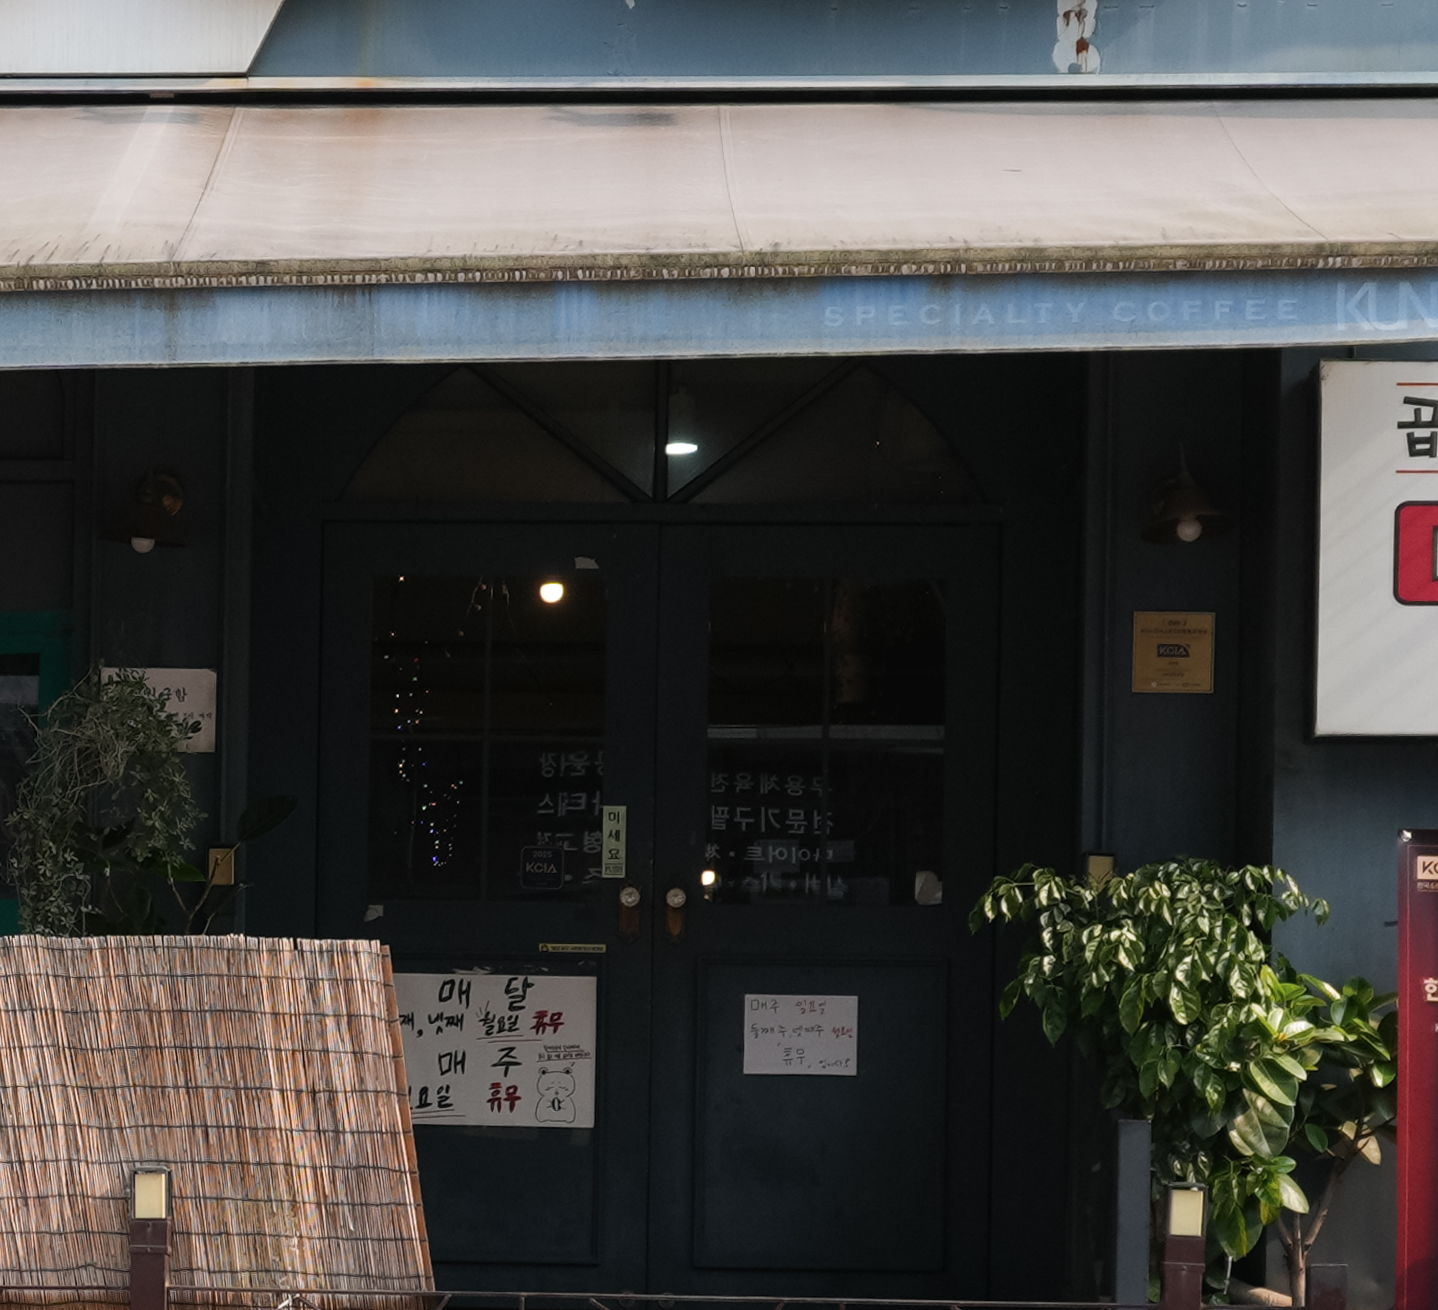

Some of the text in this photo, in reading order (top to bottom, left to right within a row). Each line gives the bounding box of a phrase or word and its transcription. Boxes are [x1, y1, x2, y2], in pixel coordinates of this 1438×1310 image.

[825, 302, 1086, 329] SPECIALTY
[1113, 298, 1298, 324] COFFEE
[525, 861, 558, 874] KCIA
[530, 1010, 565, 1035] 휴무
[409, 1084, 454, 1111] 요일
